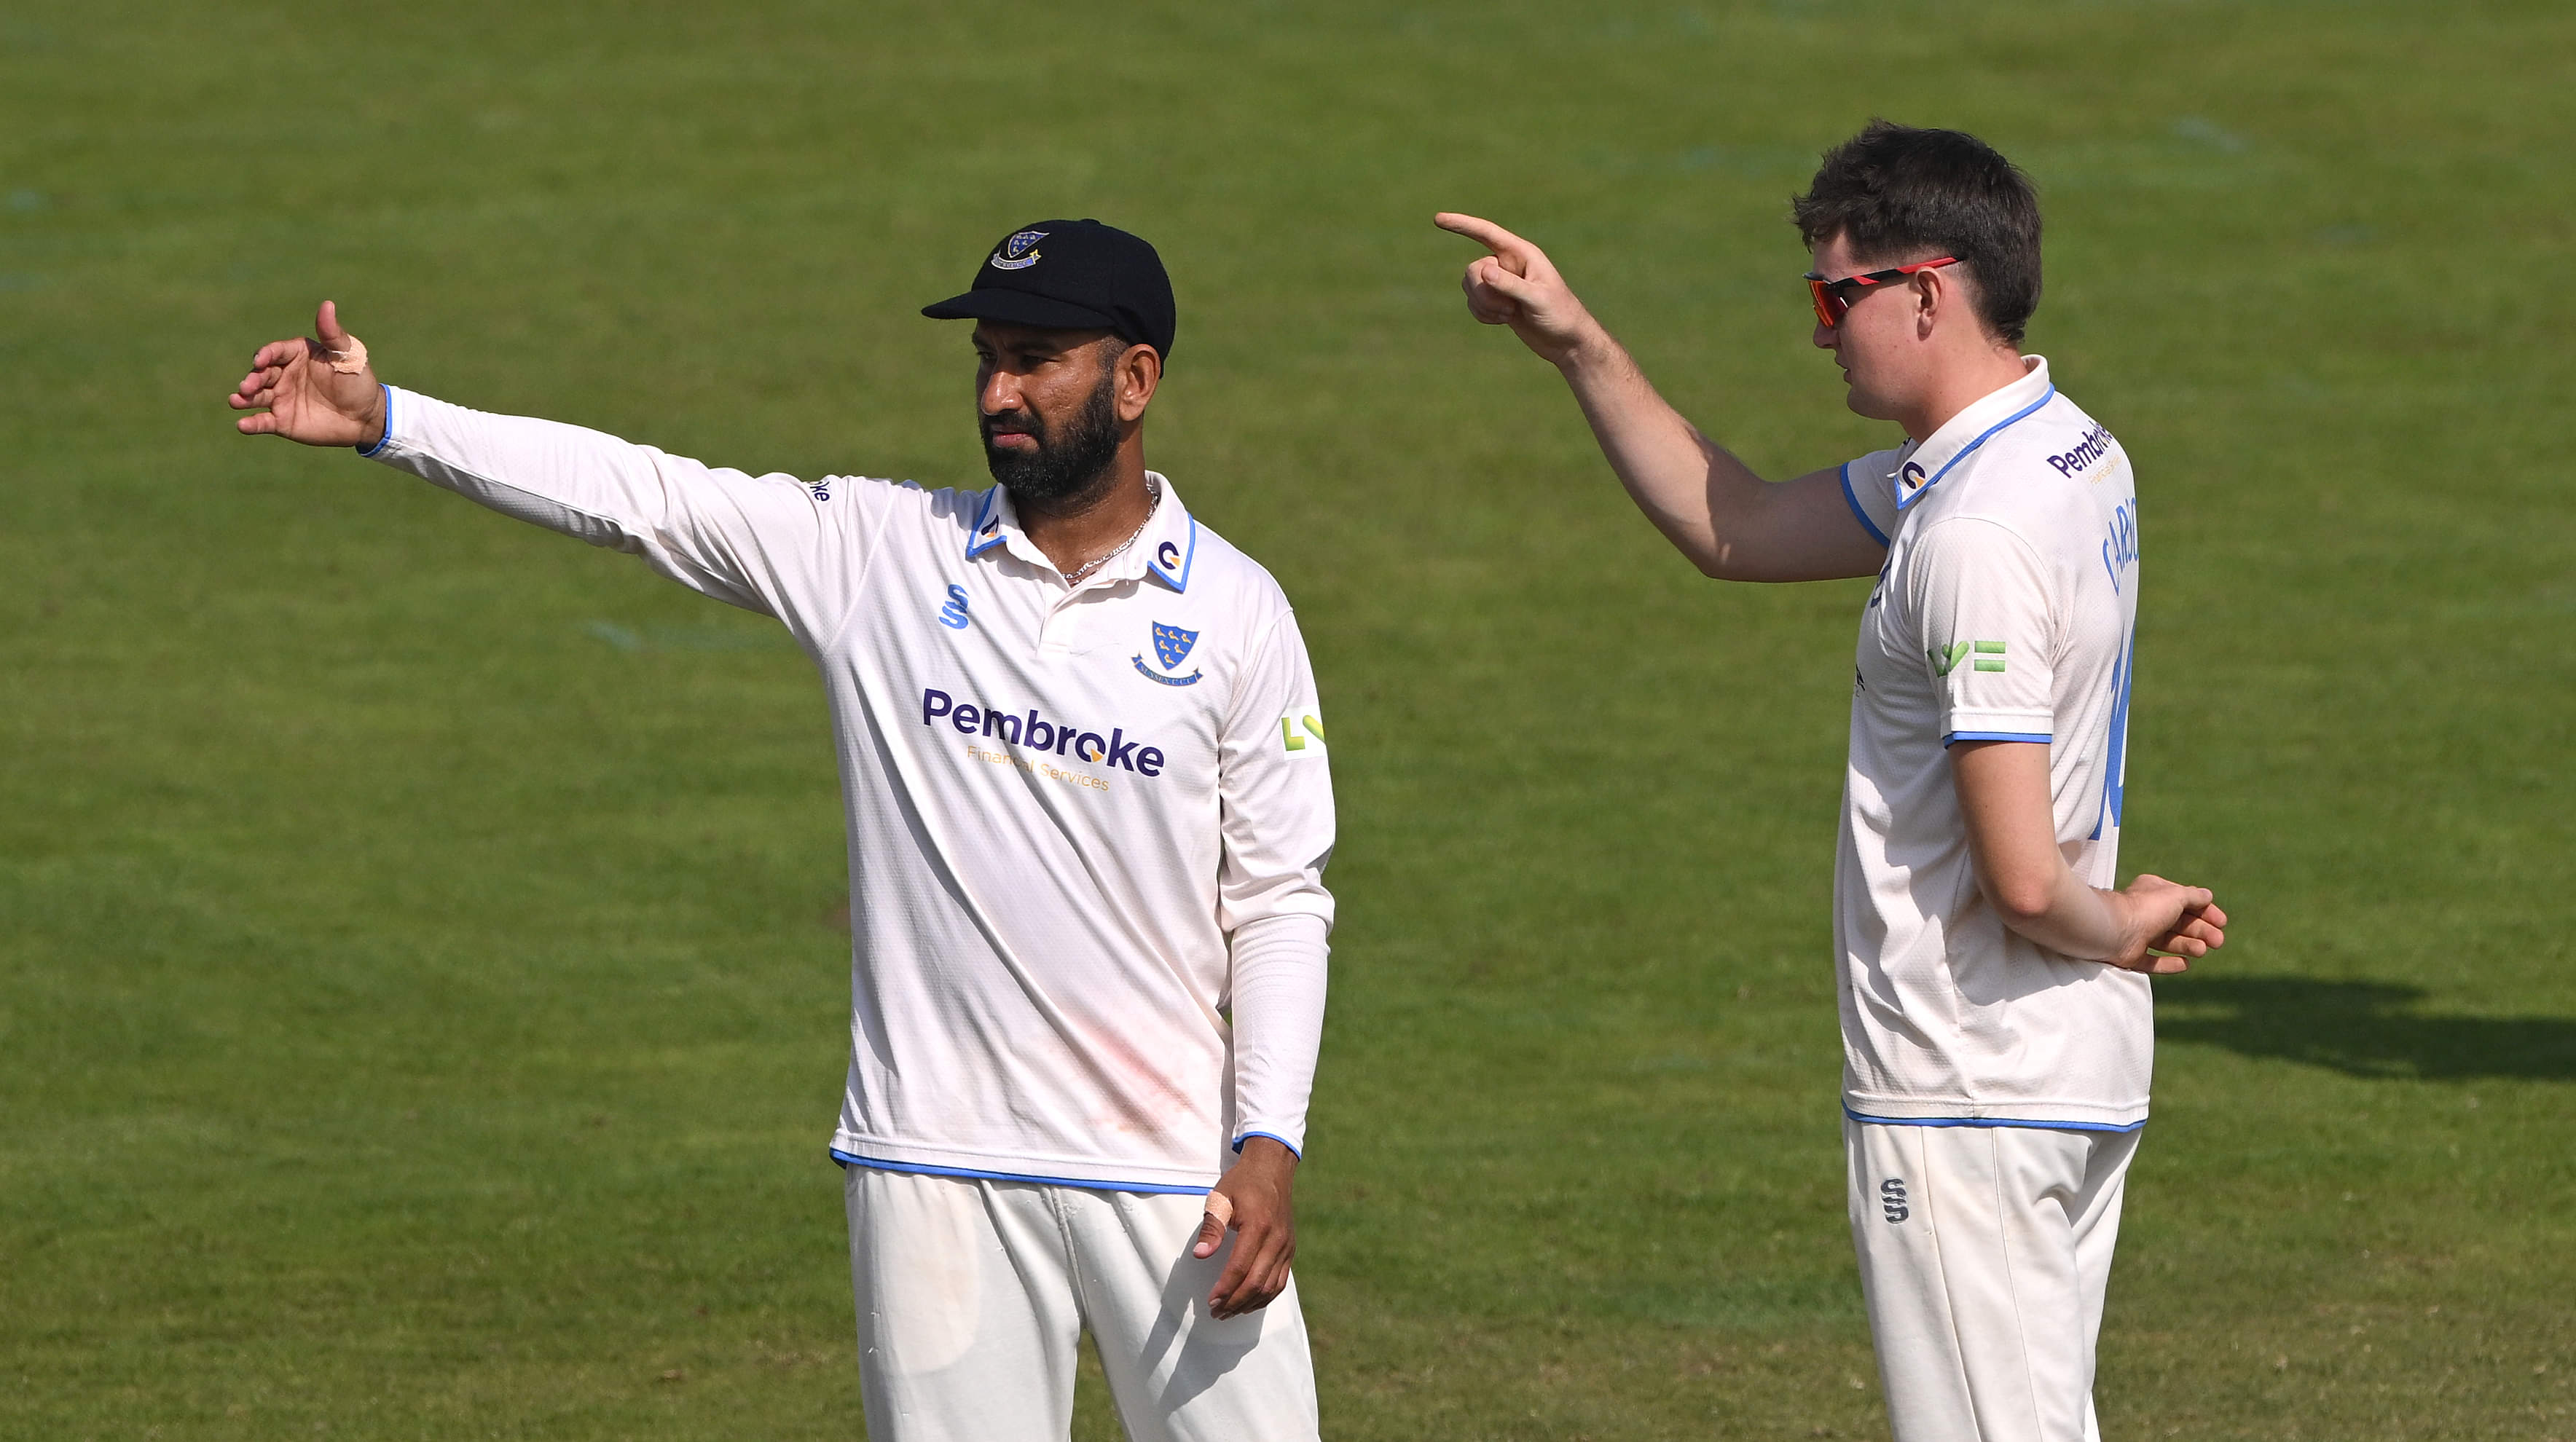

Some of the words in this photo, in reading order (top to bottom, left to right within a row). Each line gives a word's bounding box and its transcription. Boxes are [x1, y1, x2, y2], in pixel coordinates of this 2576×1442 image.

[923, 687, 1165, 777] Pembroke
[967, 745, 1034, 773] Financal
[1040, 763, 1110, 791] Services
